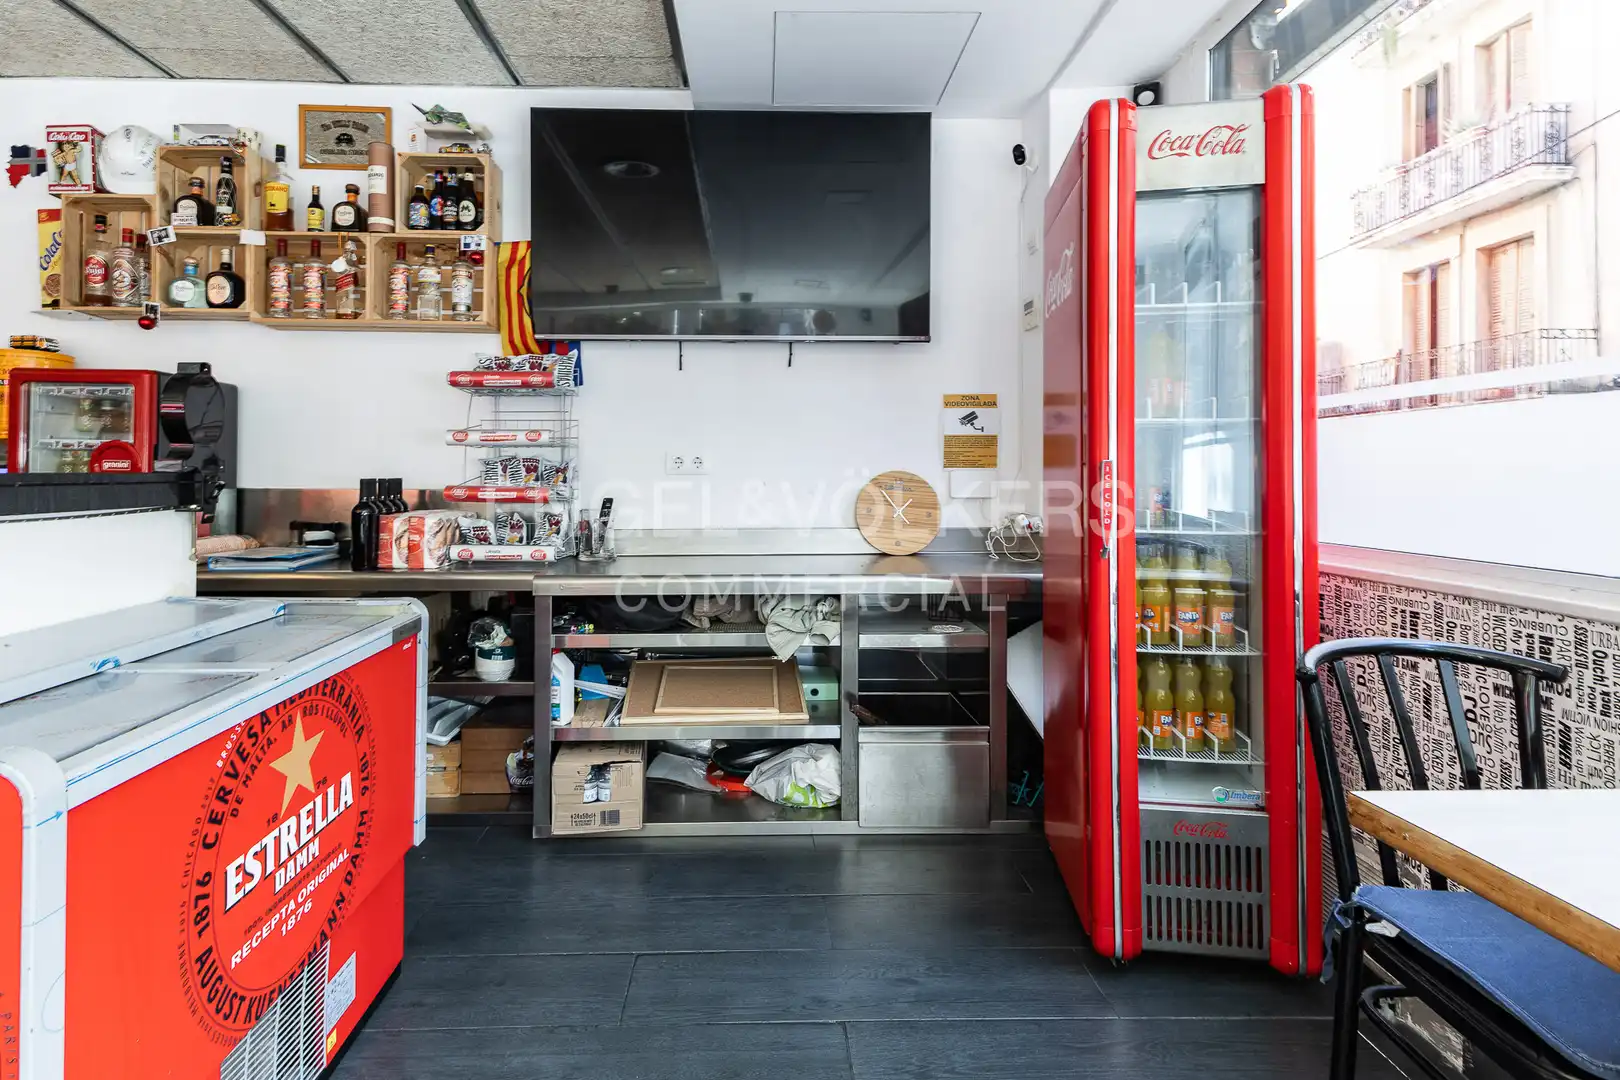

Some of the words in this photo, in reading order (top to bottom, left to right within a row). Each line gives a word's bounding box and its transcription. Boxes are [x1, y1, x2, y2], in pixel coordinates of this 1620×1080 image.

[1147, 123, 1252, 160] Coca-Cola
[39, 230, 62, 271] ColaC
[1391, 622, 1399, 638] Blo
[1421, 612, 1433, 638] PART
[1446, 620, 1458, 643] Ouc
[1492, 614, 1508, 652] WICKED
[1591, 630, 1620, 650] URBA
[1573, 624, 1589, 671] DISTRESS
[1592, 649, 1610, 688] Ouch!
[1432, 738, 1444, 774] WICKED
[1558, 720, 1573, 772] POWER
[1603, 737, 1617, 789] PERFECTIO
[202, 710, 272, 851] CERVESA
[224, 771, 354, 916] ESTRELLA
[1173, 819, 1229, 839] Coca-Cola
[274, 836, 320, 897] DAMM
[194, 871, 211, 940] 1876
[231, 897, 297, 971] RECEPTA
[297, 848, 350, 904] ORIGINAL
[281, 899, 313, 937] 1876
[194, 944, 247, 1025] AUGUST
